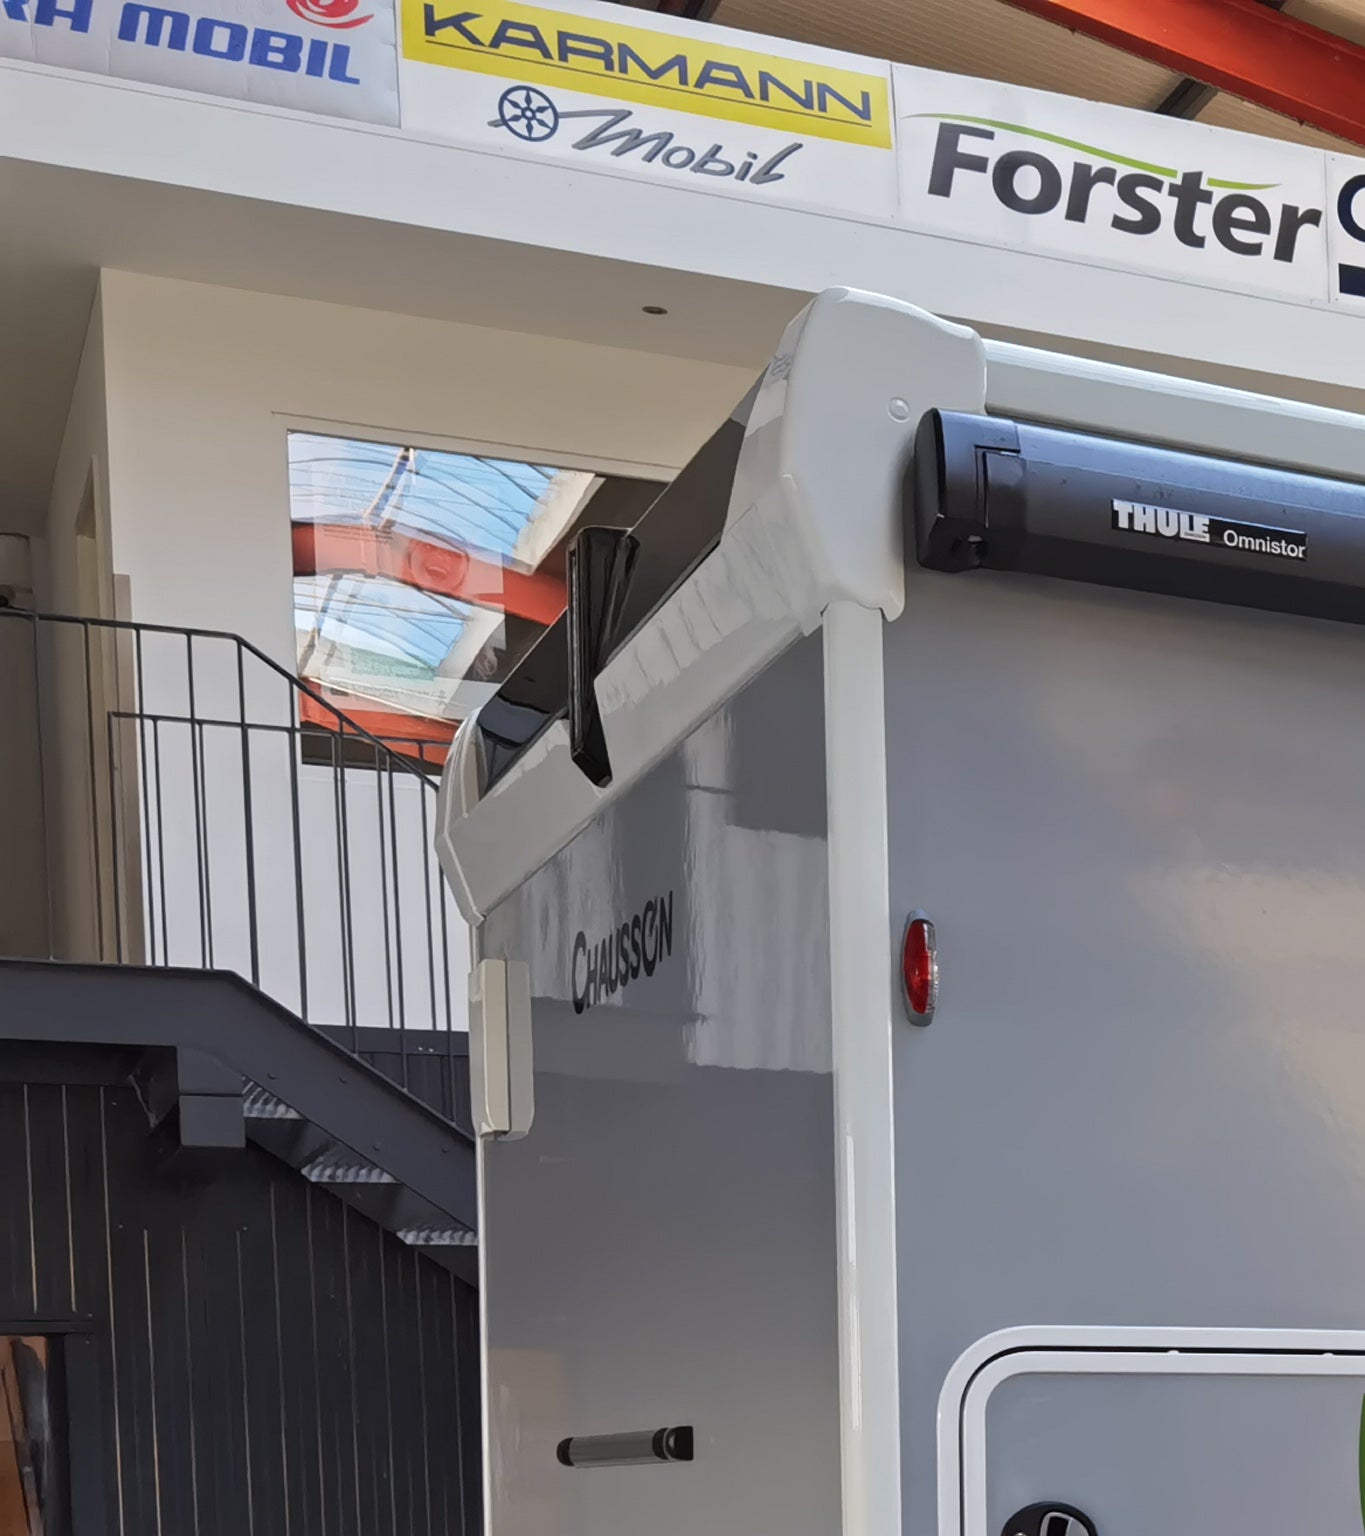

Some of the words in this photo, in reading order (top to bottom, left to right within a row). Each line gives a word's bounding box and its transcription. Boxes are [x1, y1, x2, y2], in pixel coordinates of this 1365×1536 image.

[118, 2, 361, 85] MOBIL
[423, 3, 872, 122] KARMANN
[557, 108, 803, 185] Mobil
[927, 121, 1323, 263] Forster
[1113, 500, 1210, 543] THULE
[1223, 529, 1306, 559] Omnistor
[572, 890, 673, 1015] CHAUSSON
